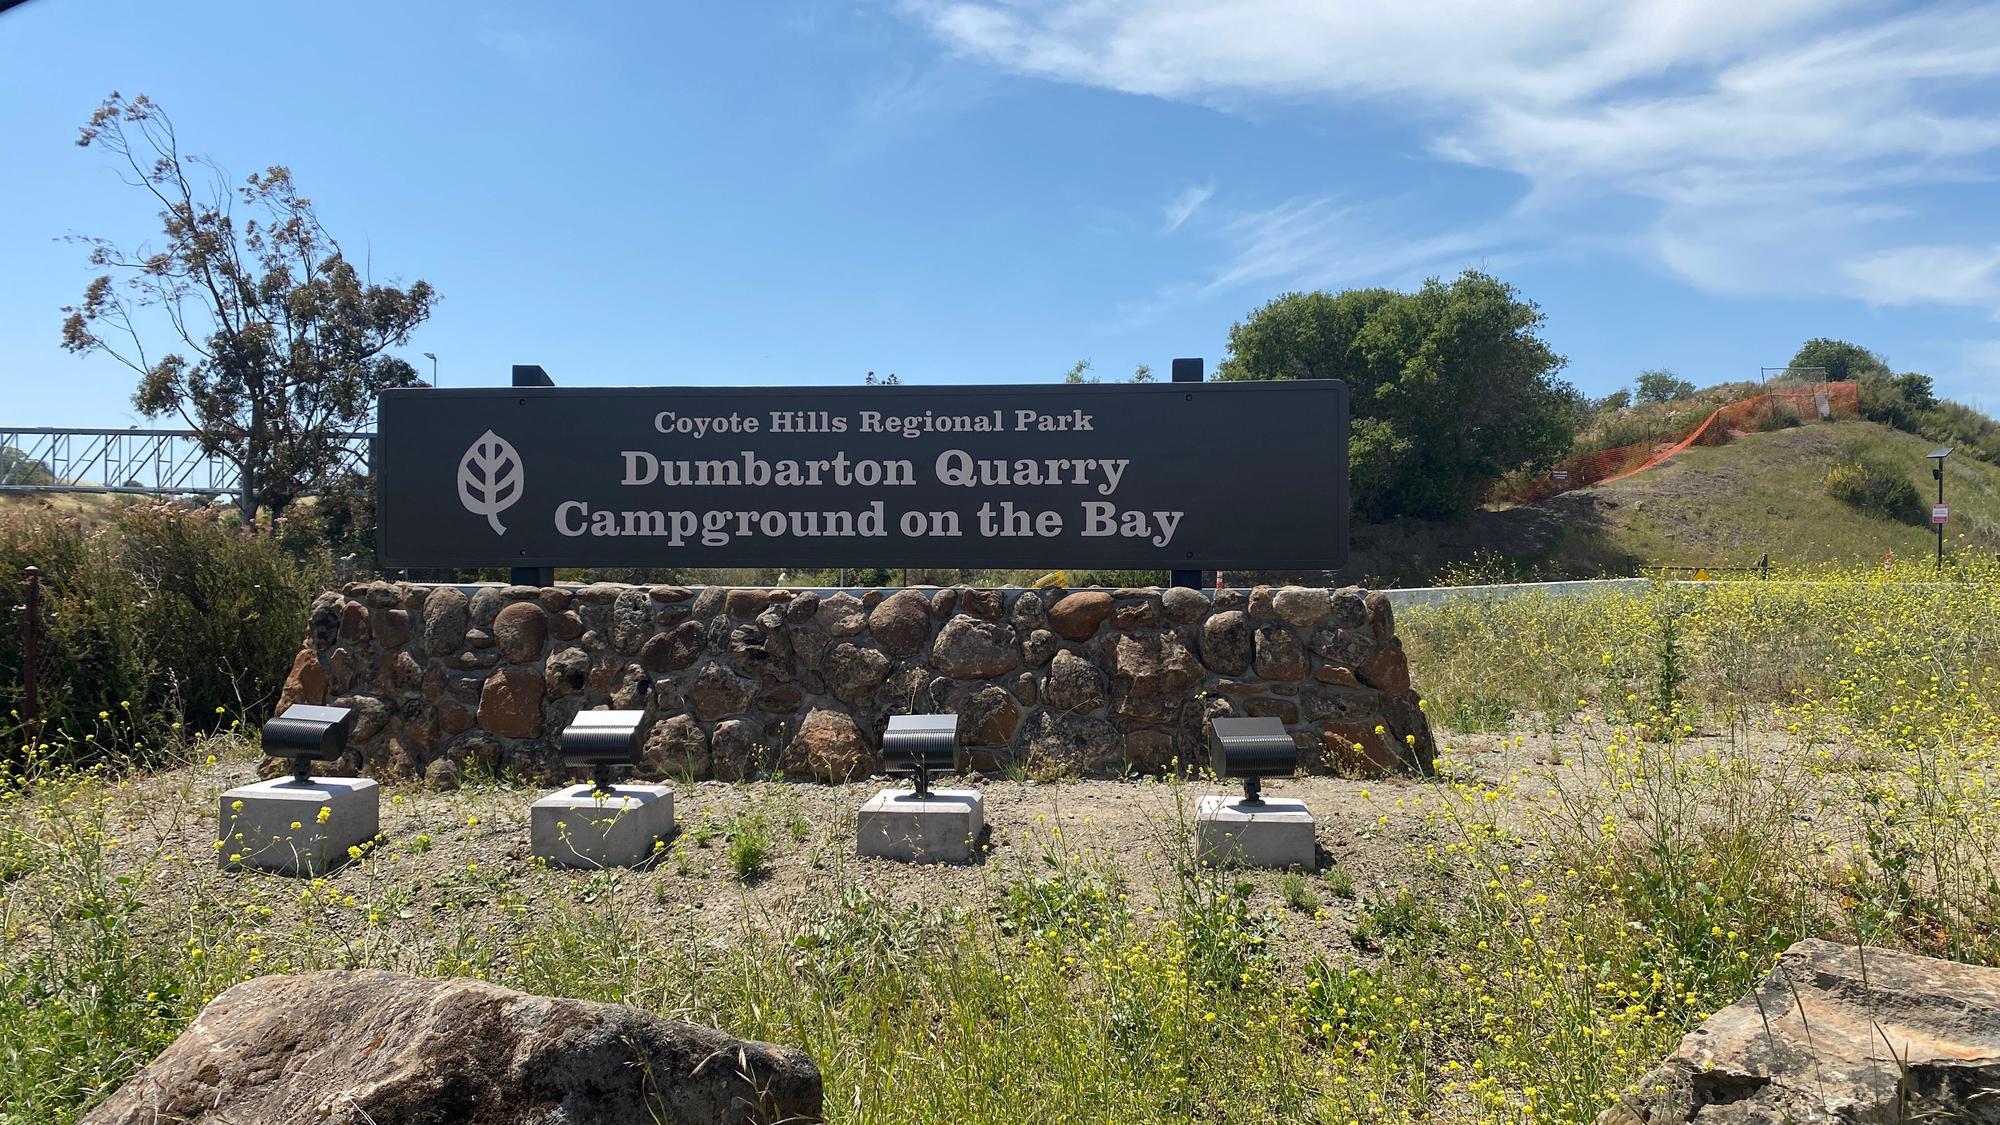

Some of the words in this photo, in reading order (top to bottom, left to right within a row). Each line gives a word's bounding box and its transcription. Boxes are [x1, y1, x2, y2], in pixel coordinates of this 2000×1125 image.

[655, 411, 760, 438] Coyote
[770, 412, 848, 432] Hills
[860, 411, 1005, 438] Regional
[1015, 410, 1094, 432] Park
[621, 451, 917, 486] Dumbarton
[936, 450, 1130, 496] Quarry
[555, 501, 888, 547] Campground
[900, 511, 963, 537] on
[977, 502, 1063, 538] the
[1081, 502, 1185, 548] Bay
